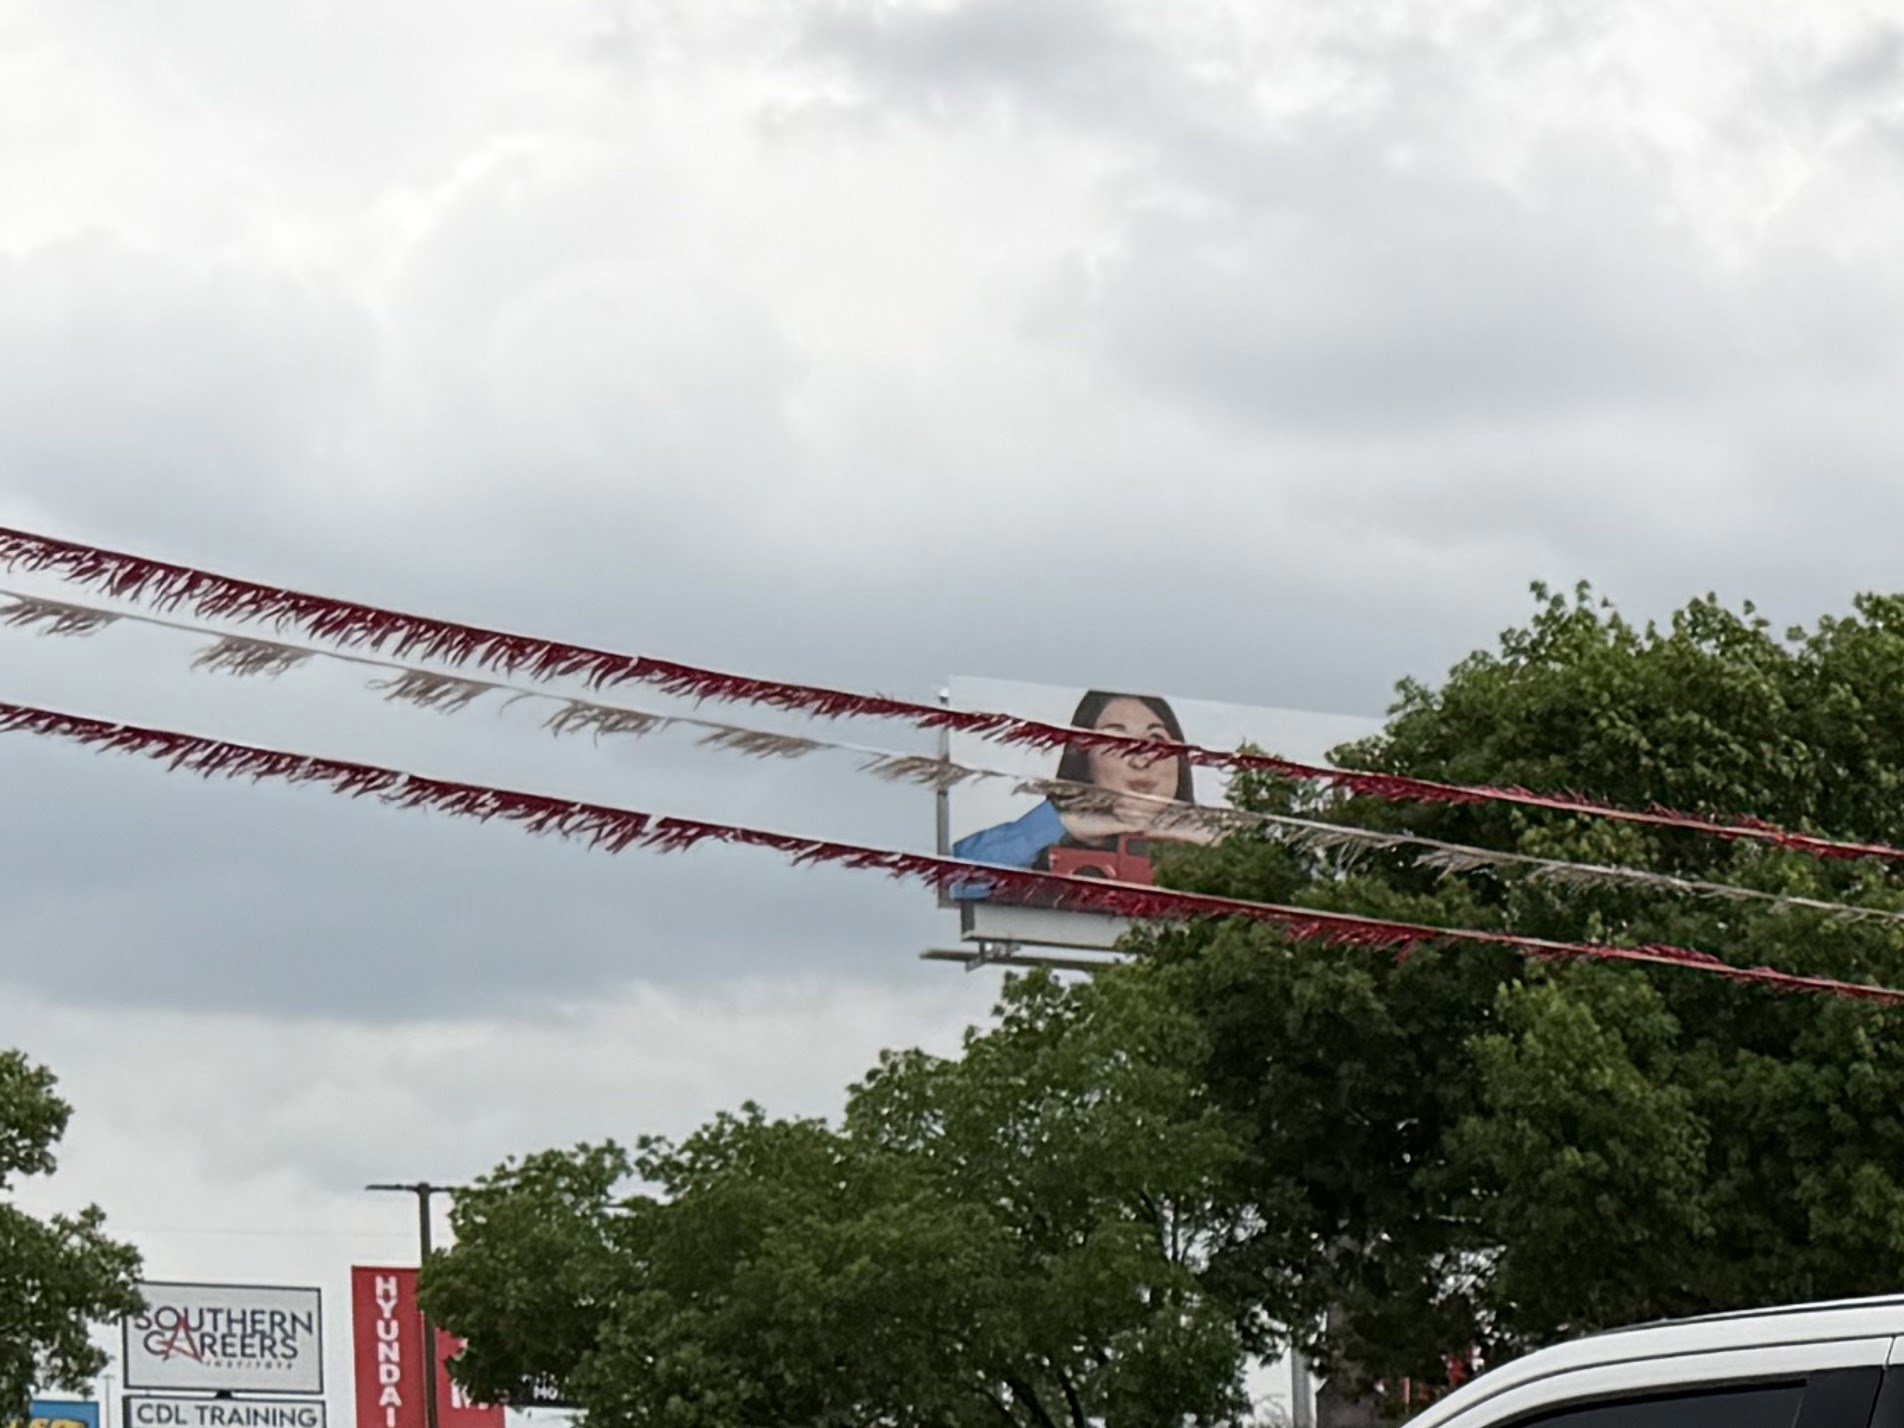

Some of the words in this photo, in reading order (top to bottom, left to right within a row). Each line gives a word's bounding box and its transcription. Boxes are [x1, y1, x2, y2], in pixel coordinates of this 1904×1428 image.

[134, 1306, 313, 1335] SOUTHERN
[143, 1318, 298, 1362] CAREERS
[375, 1275, 402, 1428] HYUNDAI
[136, 1403, 188, 1425] CDL
[195, 1404, 318, 1428] TRAINING
